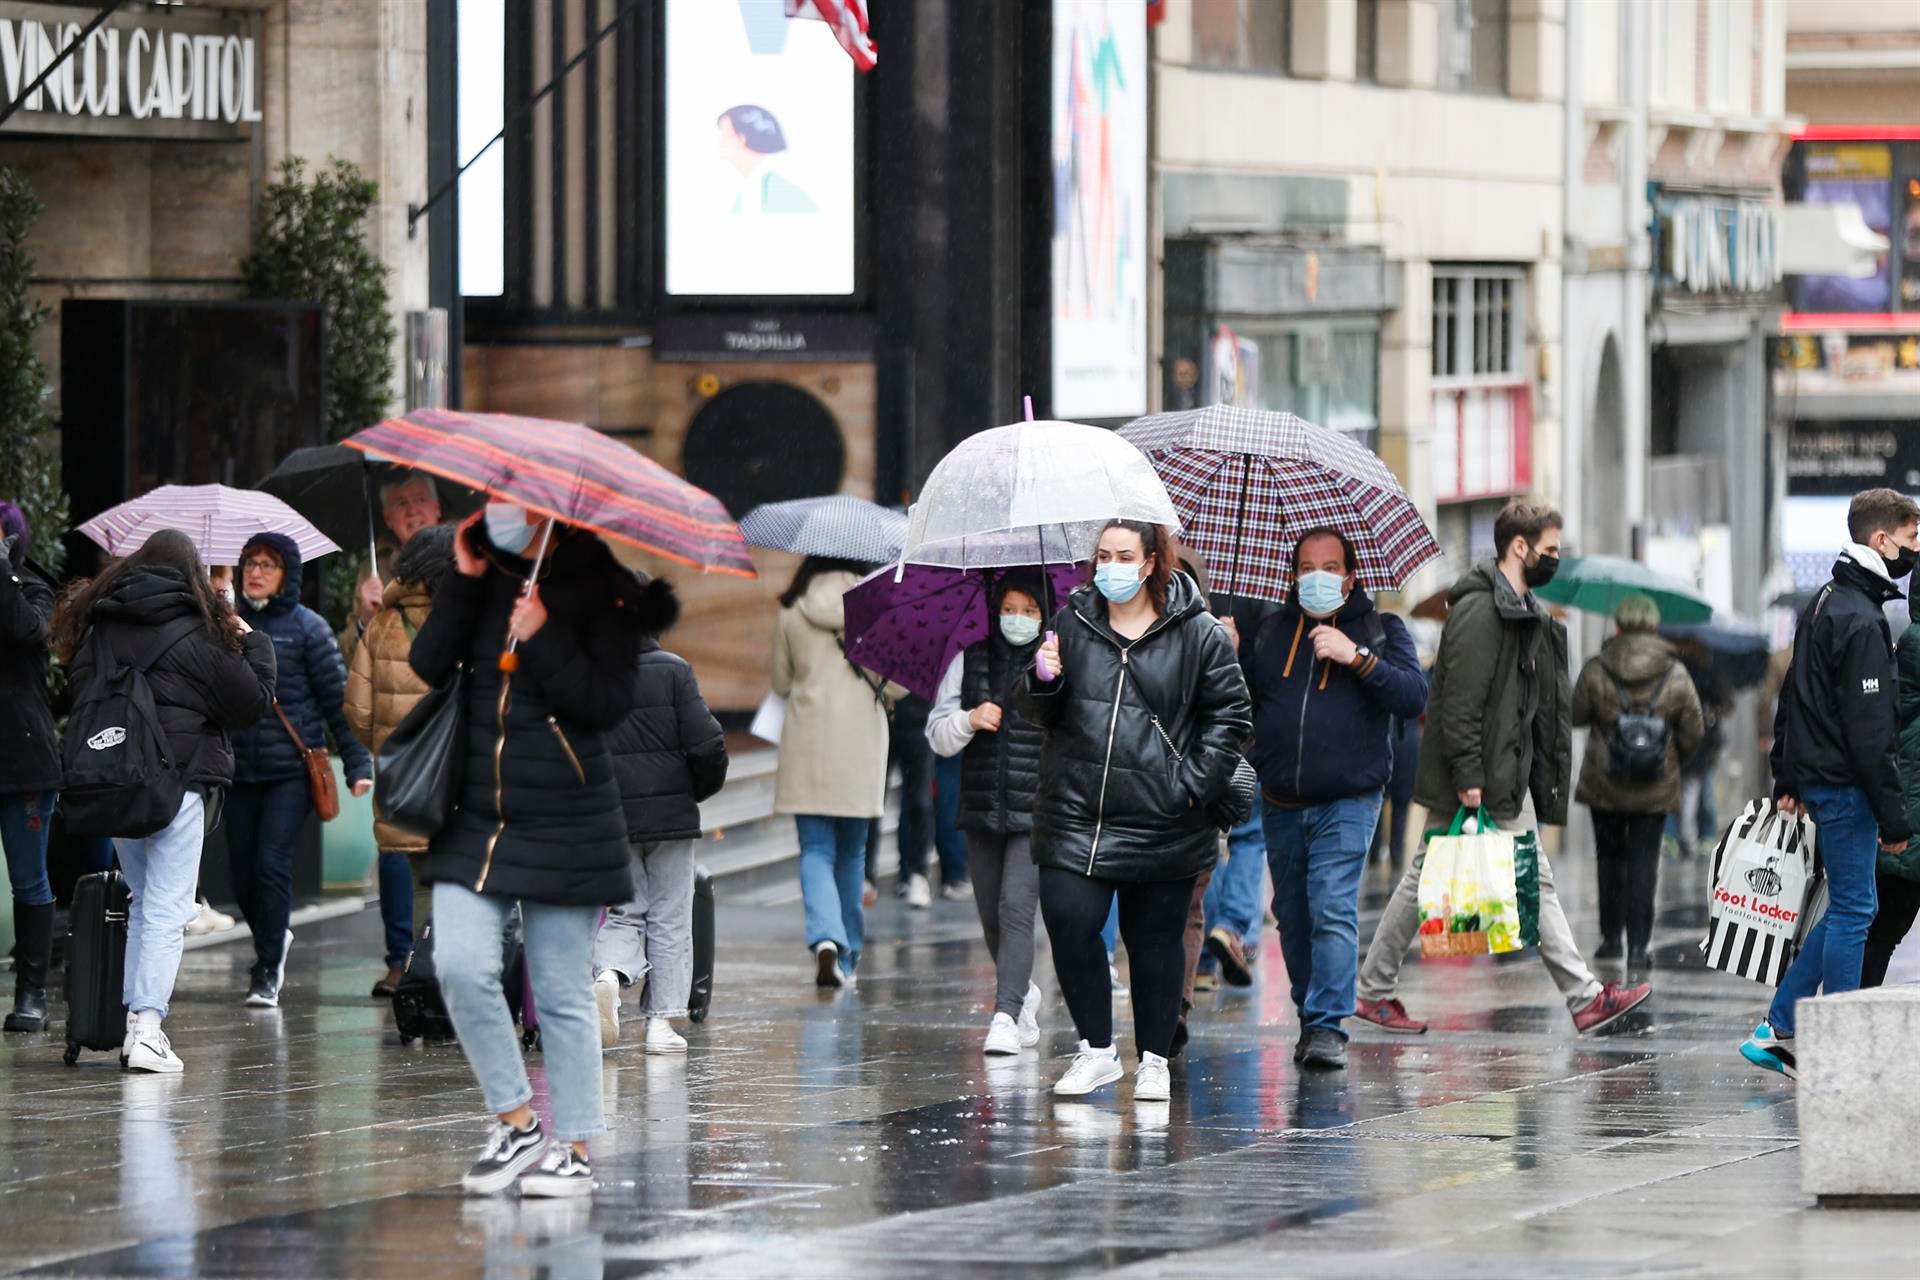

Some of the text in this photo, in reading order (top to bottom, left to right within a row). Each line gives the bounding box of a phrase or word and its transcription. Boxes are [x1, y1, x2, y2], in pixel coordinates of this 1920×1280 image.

[0, 18, 263, 124] VINCCI CAPITOL
[1714, 887, 1798, 922] Foot Locker
